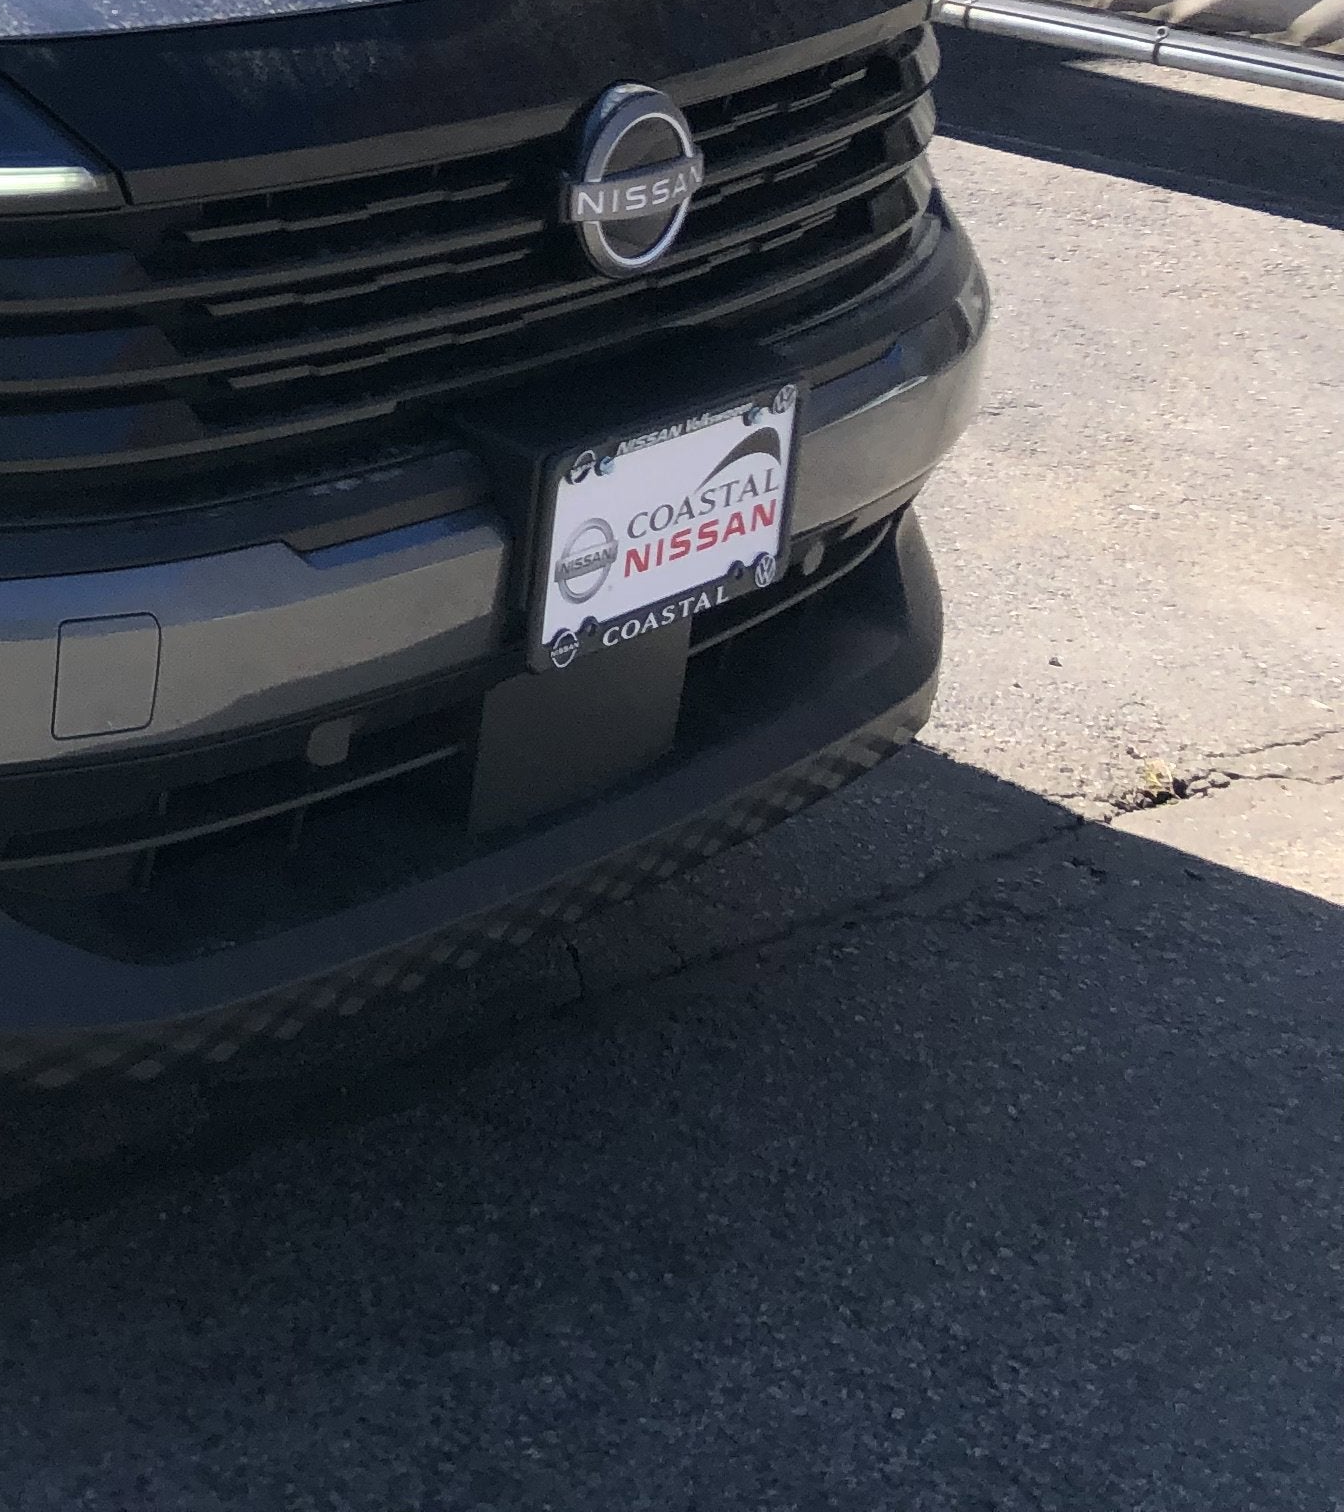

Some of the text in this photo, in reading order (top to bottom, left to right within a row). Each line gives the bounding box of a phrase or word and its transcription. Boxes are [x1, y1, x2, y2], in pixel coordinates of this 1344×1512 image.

[576, 165, 703, 215] NISSAN
[626, 467, 780, 539] COASTAL
[563, 546, 612, 574] NISSAN
[623, 498, 777, 578] NISSAN
[602, 585, 729, 646] COASTAL
